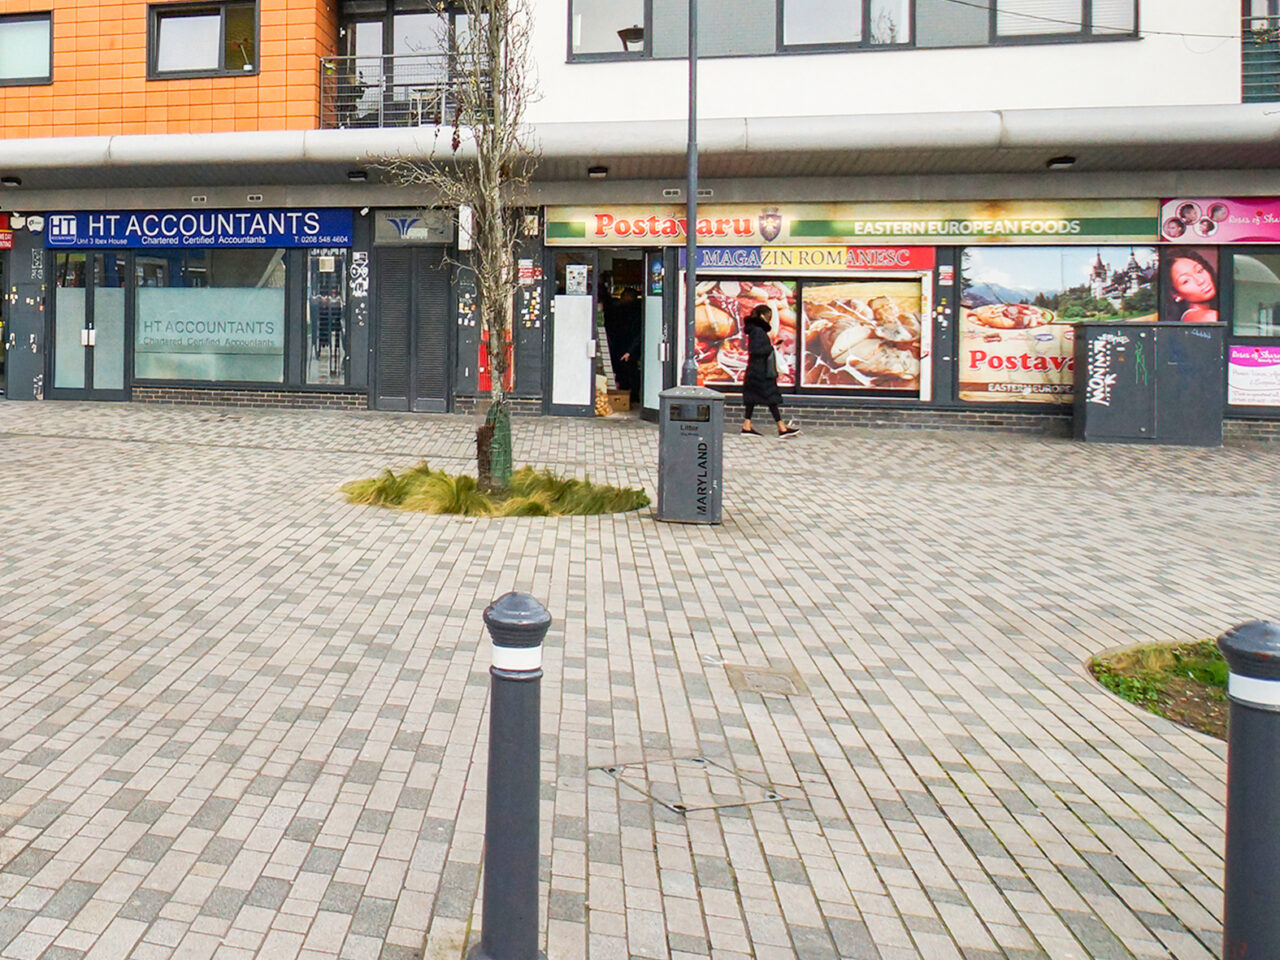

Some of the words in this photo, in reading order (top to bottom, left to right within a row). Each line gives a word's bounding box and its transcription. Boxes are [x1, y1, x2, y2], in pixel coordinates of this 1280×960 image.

[89, 215, 120, 236] HT
[125, 212, 320, 236] ACCOUNTANTS
[854, 221, 926, 235] EASTERN
[927, 220, 1018, 234] EUROPEAN
[1021, 220, 1081, 234] FOODS
[141, 236, 179, 244] Chartered
[183, 236, 215, 244] Certified
[218, 235, 266, 244] Accountants
[301, 235, 317, 243] 0208
[702, 249, 793, 266] MAGAZIN
[799, 249, 910, 266] ROMANESC
[144, 320, 162, 332] HT
[165, 321, 274, 334] ACCOUNTANTS
[697, 442, 708, 516] MARYLAND
